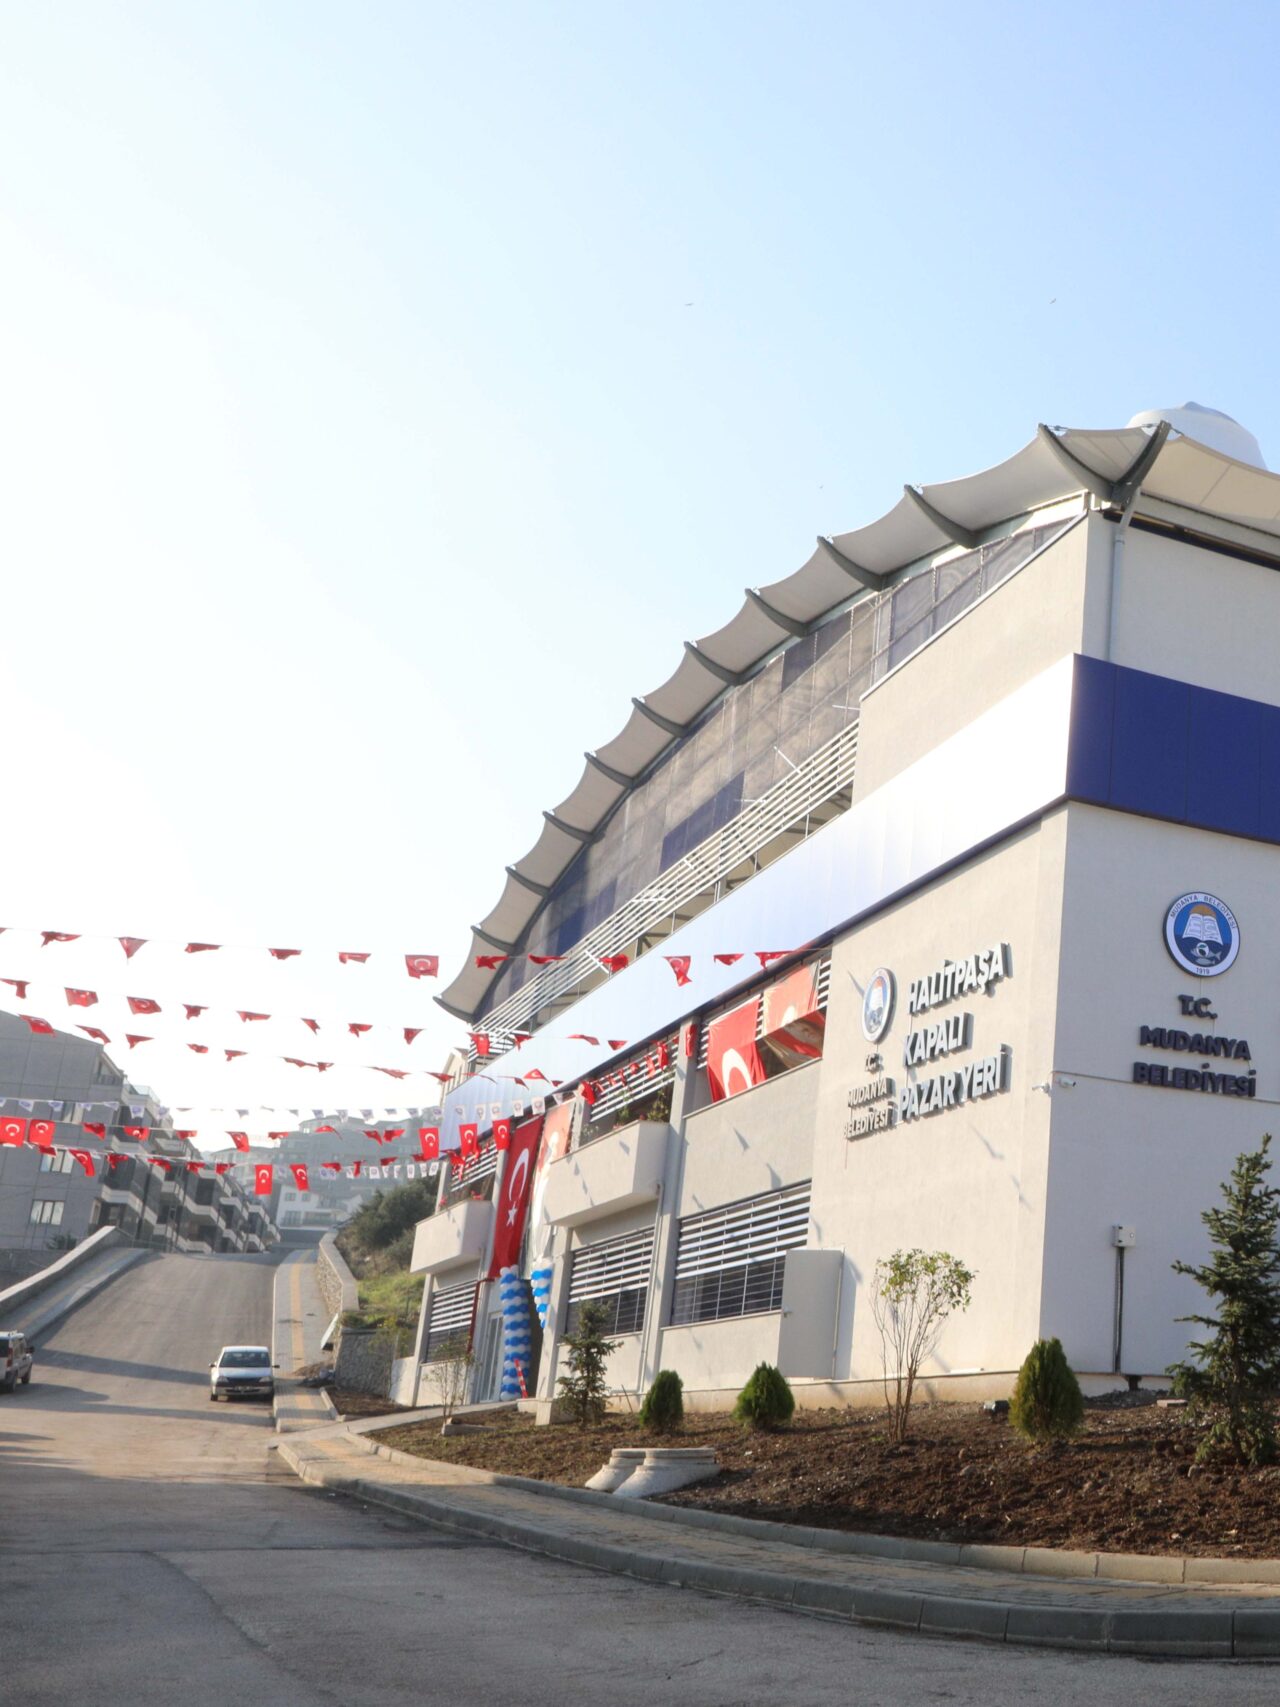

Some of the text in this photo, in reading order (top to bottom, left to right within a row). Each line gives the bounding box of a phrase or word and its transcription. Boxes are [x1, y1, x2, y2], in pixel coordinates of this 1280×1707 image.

[1170, 894, 1198, 918] MUDANYA
[909, 944, 1012, 1015] HALİTPAŞA
[1179, 994, 1218, 1019] T.C.
[903, 1012, 973, 1067] KAPALI
[1140, 1025, 1251, 1060] MUDANYA
[897, 1043, 1012, 1124] PAZAR YERİ
[1133, 1062, 1256, 1098] BELEDİYESİ
